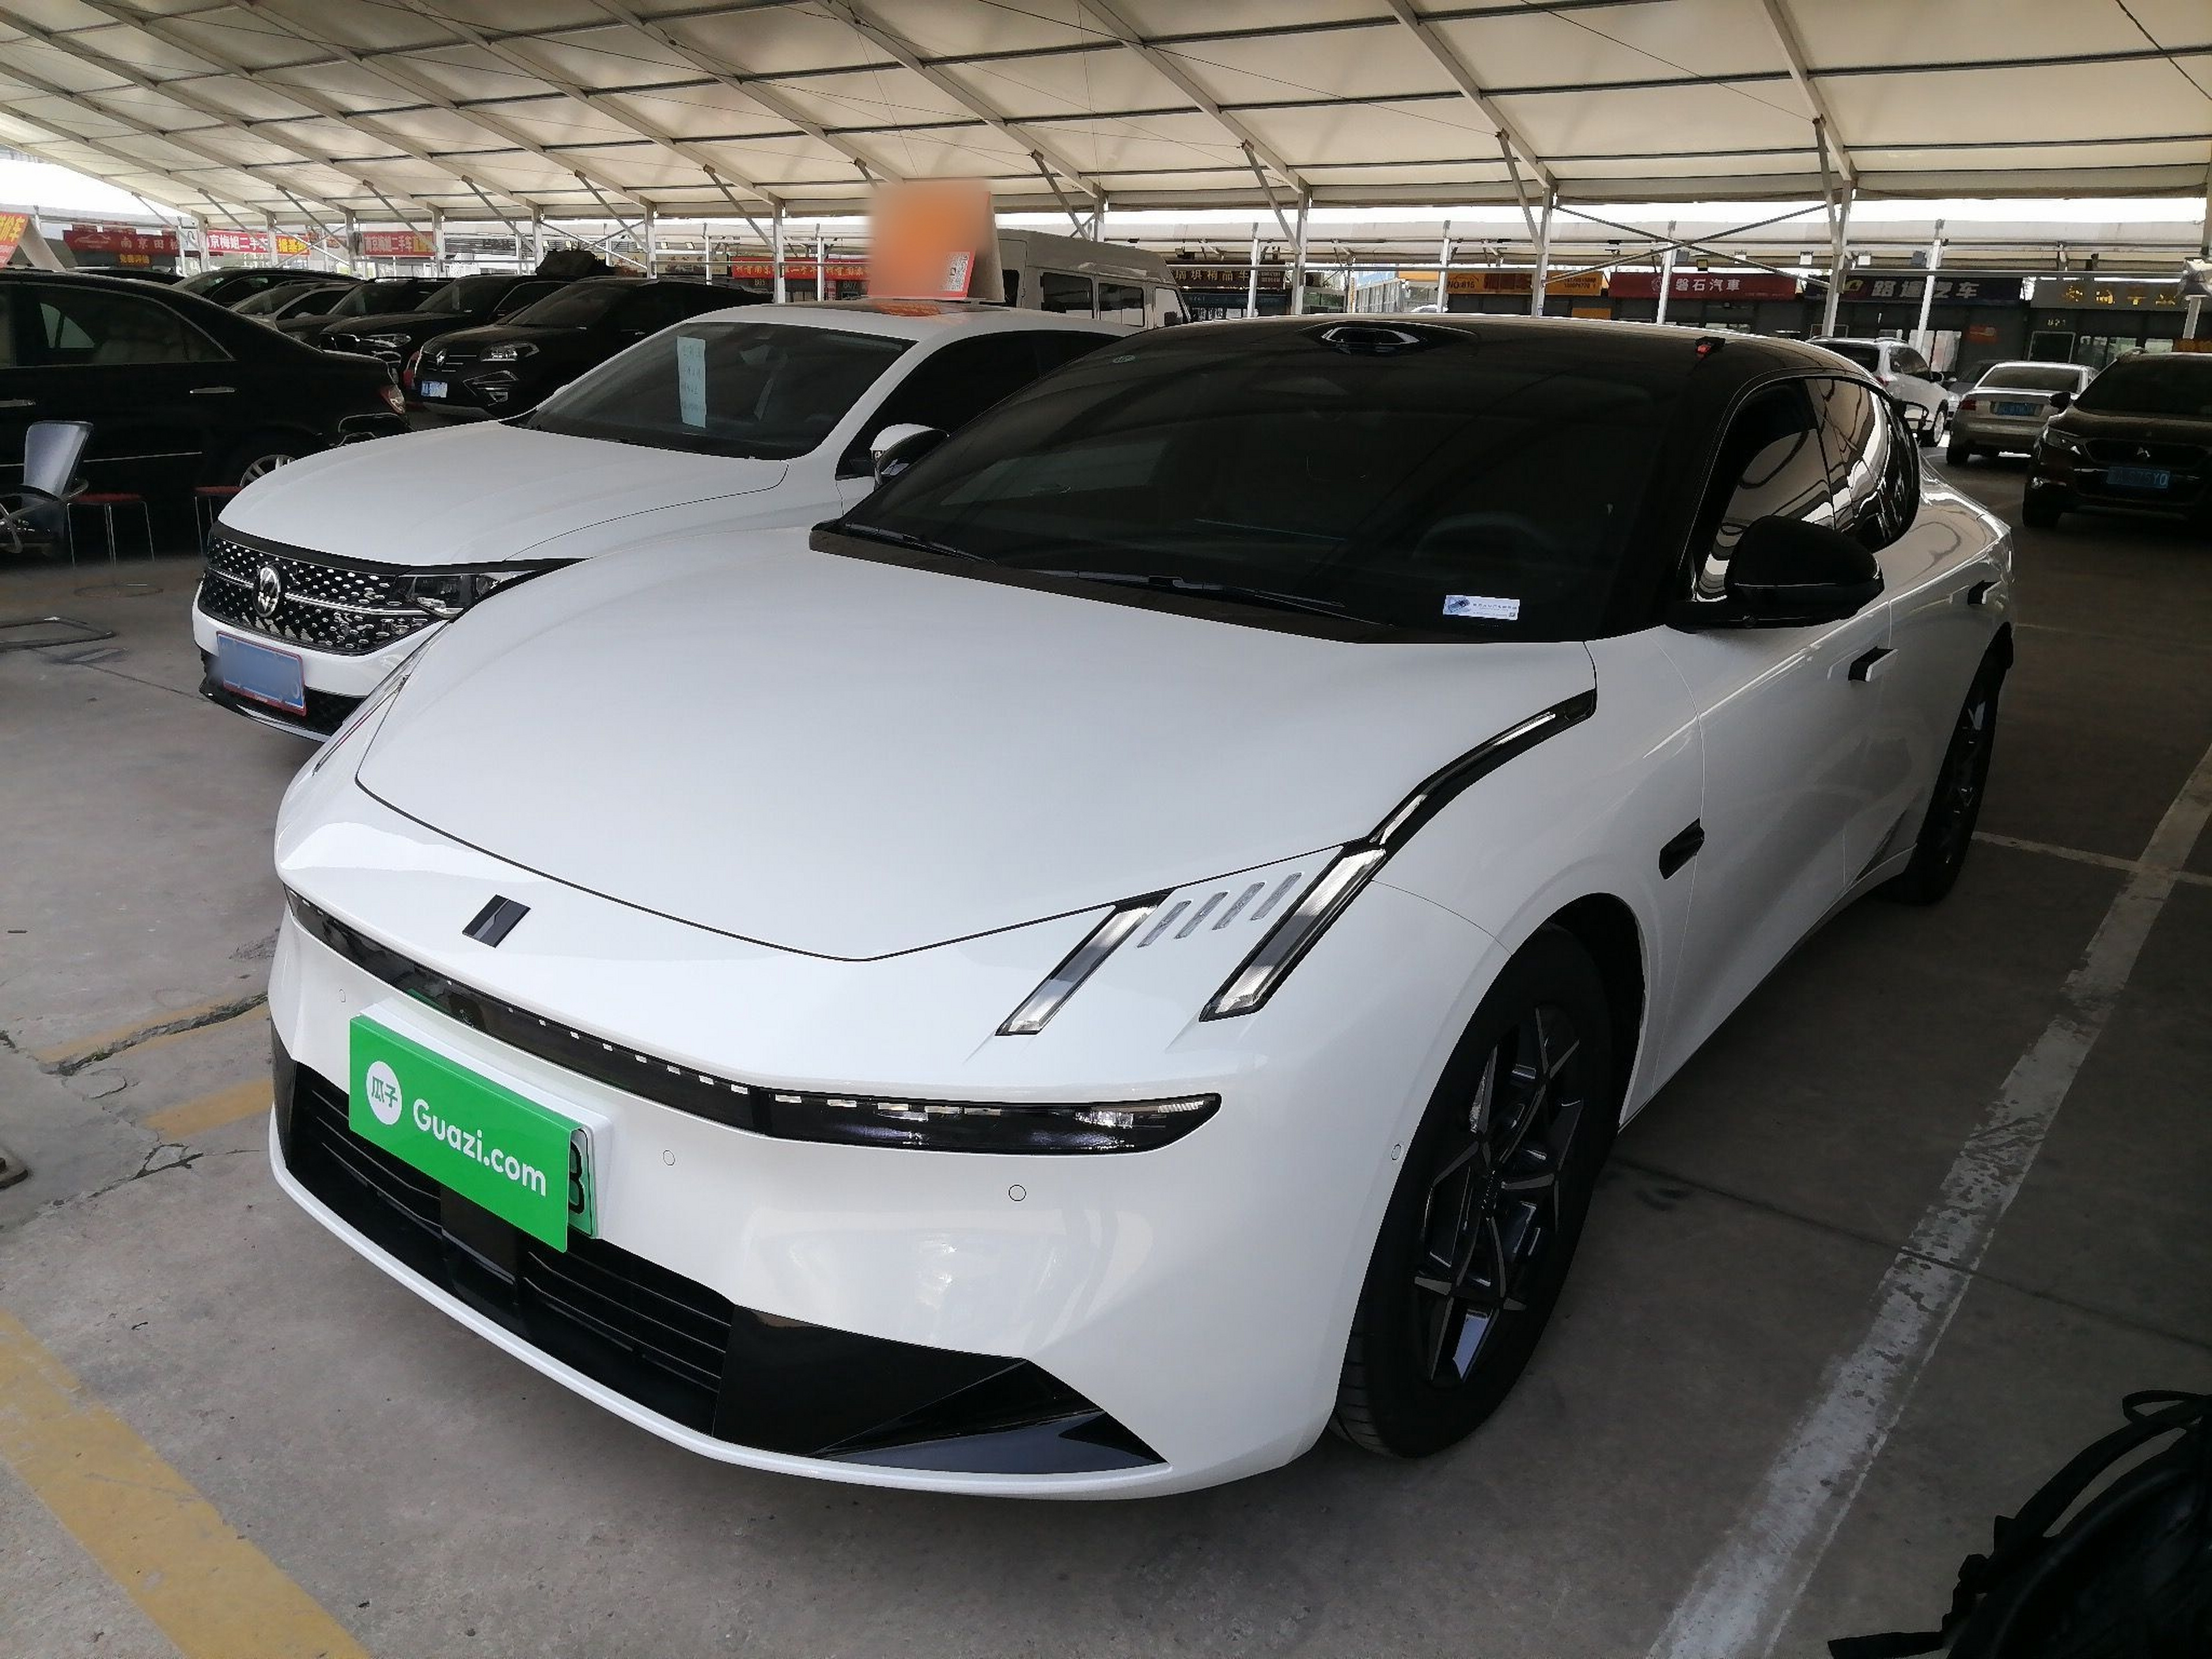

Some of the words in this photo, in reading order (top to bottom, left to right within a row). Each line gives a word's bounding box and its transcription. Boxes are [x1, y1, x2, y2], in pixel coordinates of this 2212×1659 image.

[1675, 278, 1741, 293] 磐石汽車
[371, 1075, 399, 1108] 瓜子
[412, 1098, 547, 1197] Guazi.com
